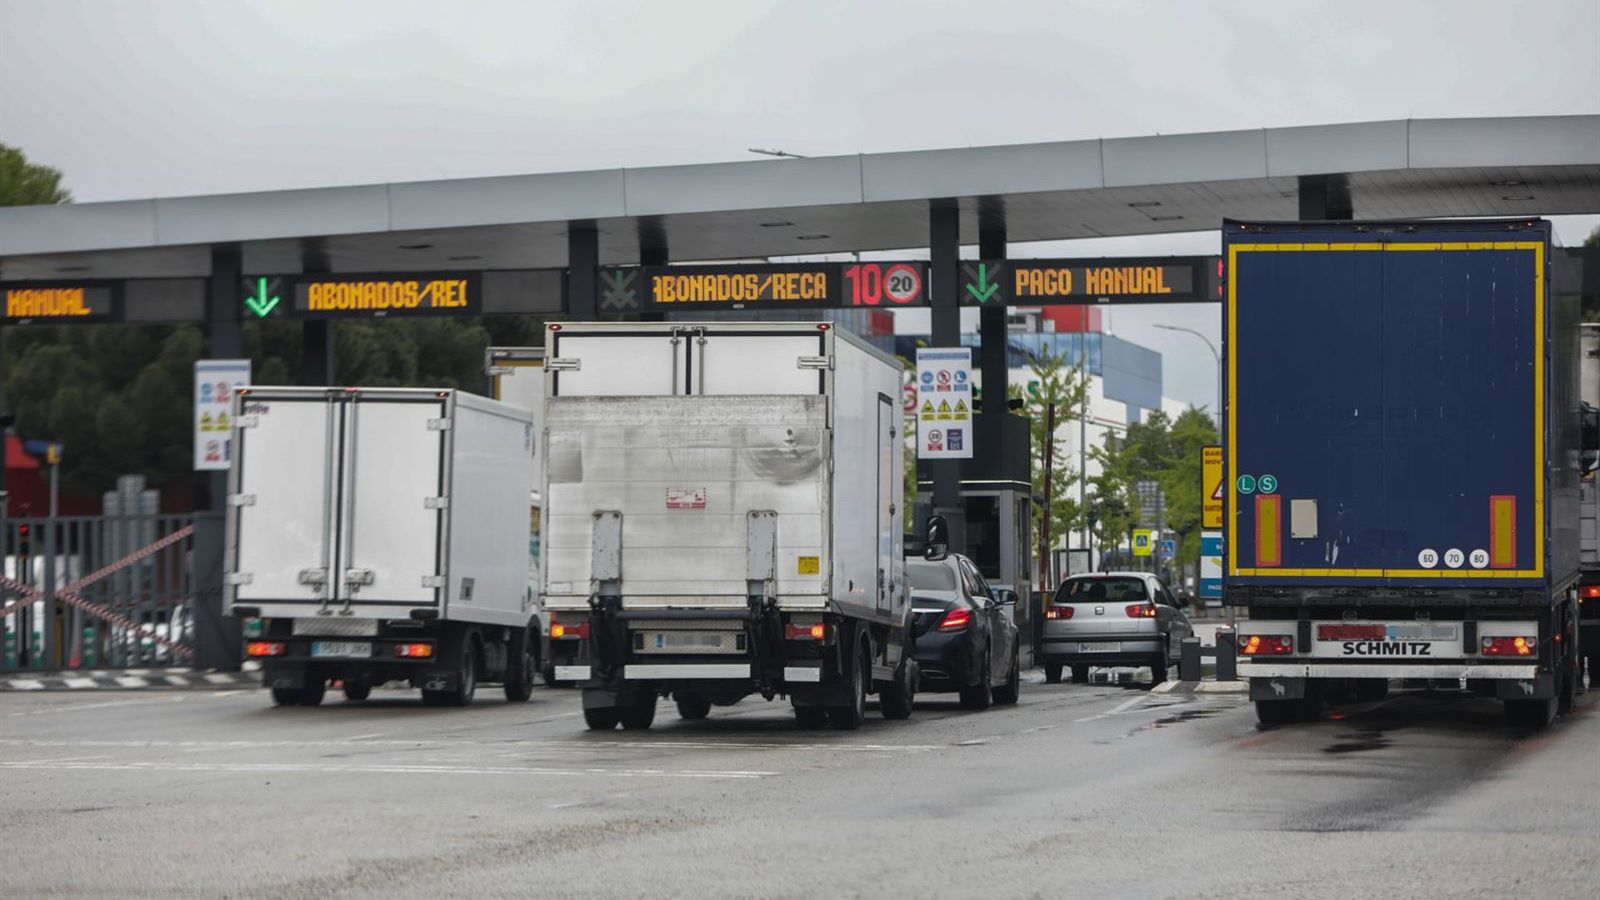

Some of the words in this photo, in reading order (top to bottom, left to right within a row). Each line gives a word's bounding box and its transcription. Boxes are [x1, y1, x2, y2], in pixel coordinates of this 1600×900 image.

[844, 263, 881, 305] 10
[891, 276, 912, 292] 20
[1015, 268, 1072, 296] PAGO
[1085, 266, 1171, 295] MANUAL
[6, 287, 92, 317] MANUAL
[1242, 477, 1251, 490] L
[1262, 477, 1272, 490] S
[1423, 554, 1434, 563] 60
[1449, 554, 1459, 563] 70
[1474, 554, 1484, 563] 80
[1342, 642, 1431, 655] SCHMITZ
